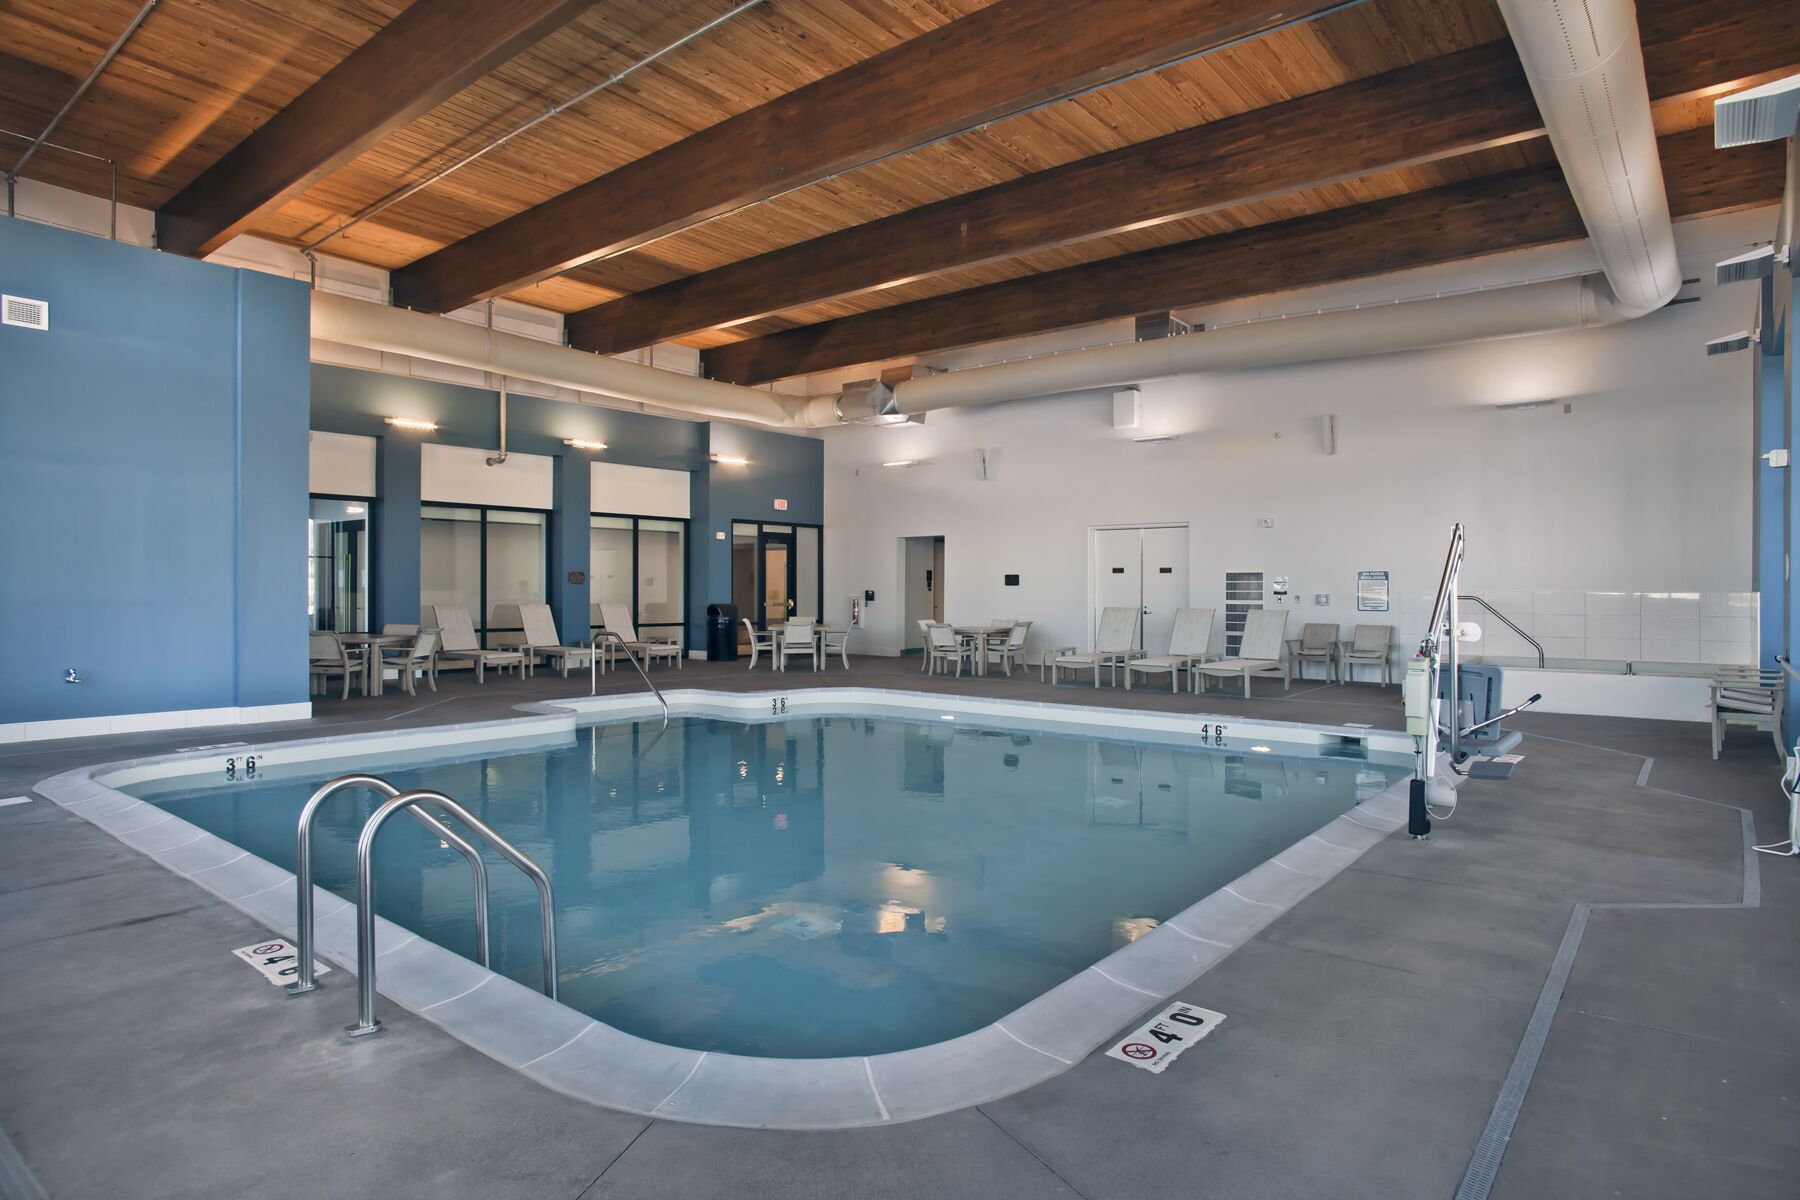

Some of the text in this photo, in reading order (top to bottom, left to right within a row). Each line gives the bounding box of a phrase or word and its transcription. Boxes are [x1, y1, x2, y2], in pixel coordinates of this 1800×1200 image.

[772, 697, 786, 707] 3 6
[1201, 724, 1208, 735] 4
[1215, 725, 1222, 736] 6
[226, 757, 236, 771] 3
[246, 756, 256, 769] 6
[263, 955, 296, 966] 4
[1149, 1006, 1204, 1044] 4 FT 0 IN
